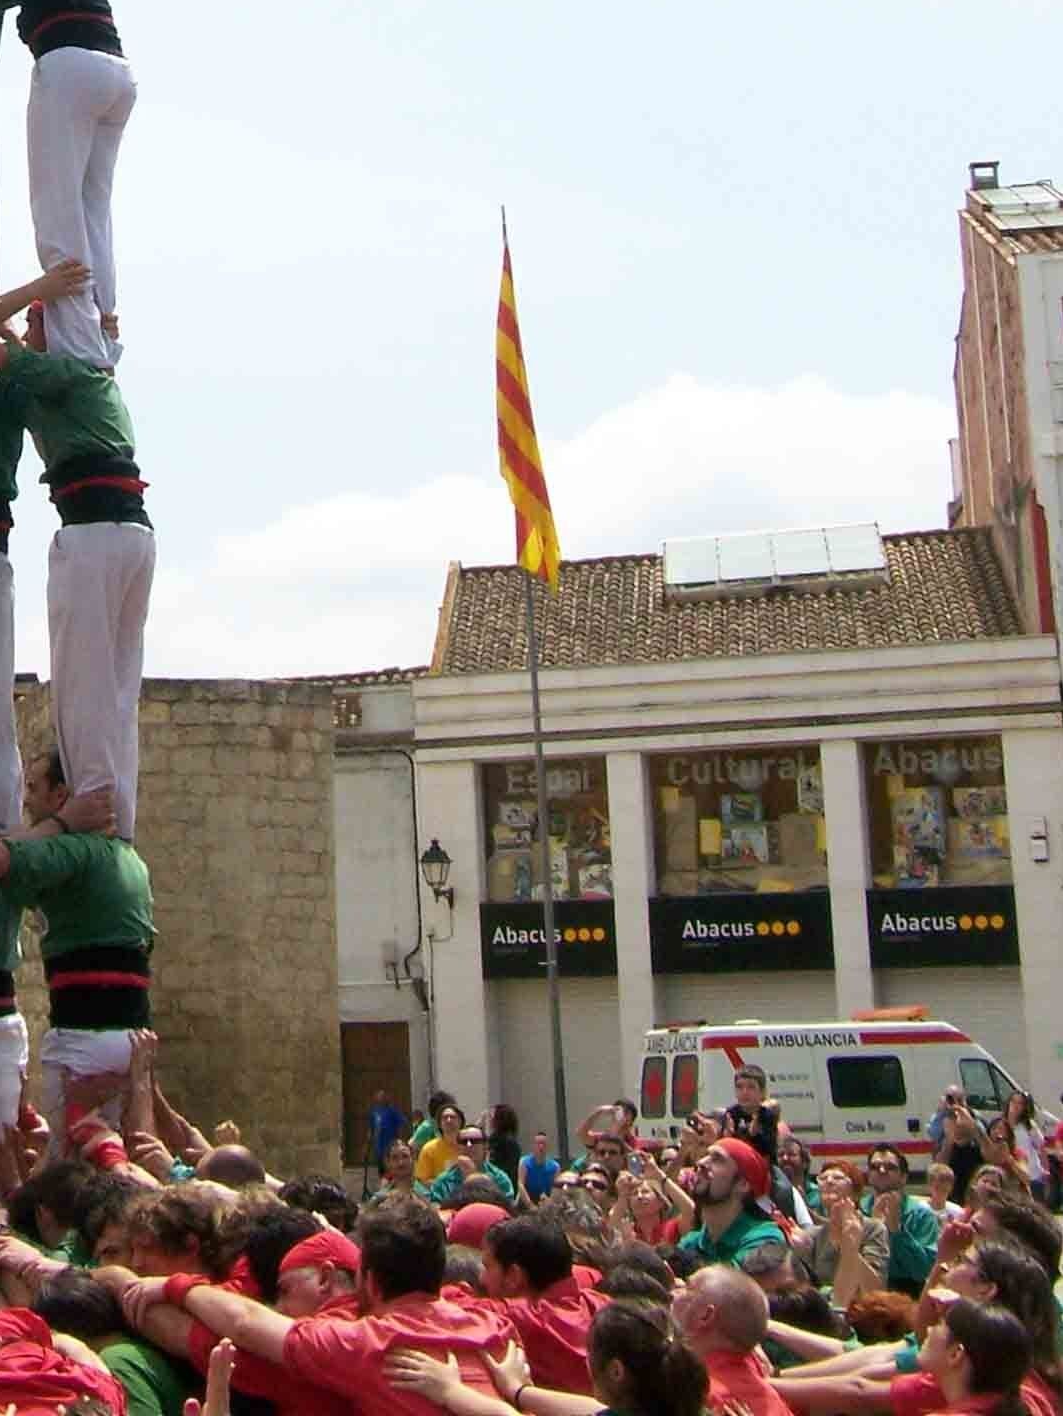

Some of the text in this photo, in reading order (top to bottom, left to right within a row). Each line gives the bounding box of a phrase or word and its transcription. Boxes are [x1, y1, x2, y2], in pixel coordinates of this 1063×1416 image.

[667, 750, 805, 784] Cultural
[874, 741, 1003, 776] Abacus
[681, 920, 755, 938] Abacus
[881, 912, 956, 932] Abacus
[763, 1033, 857, 1048] AMBULANCIA
